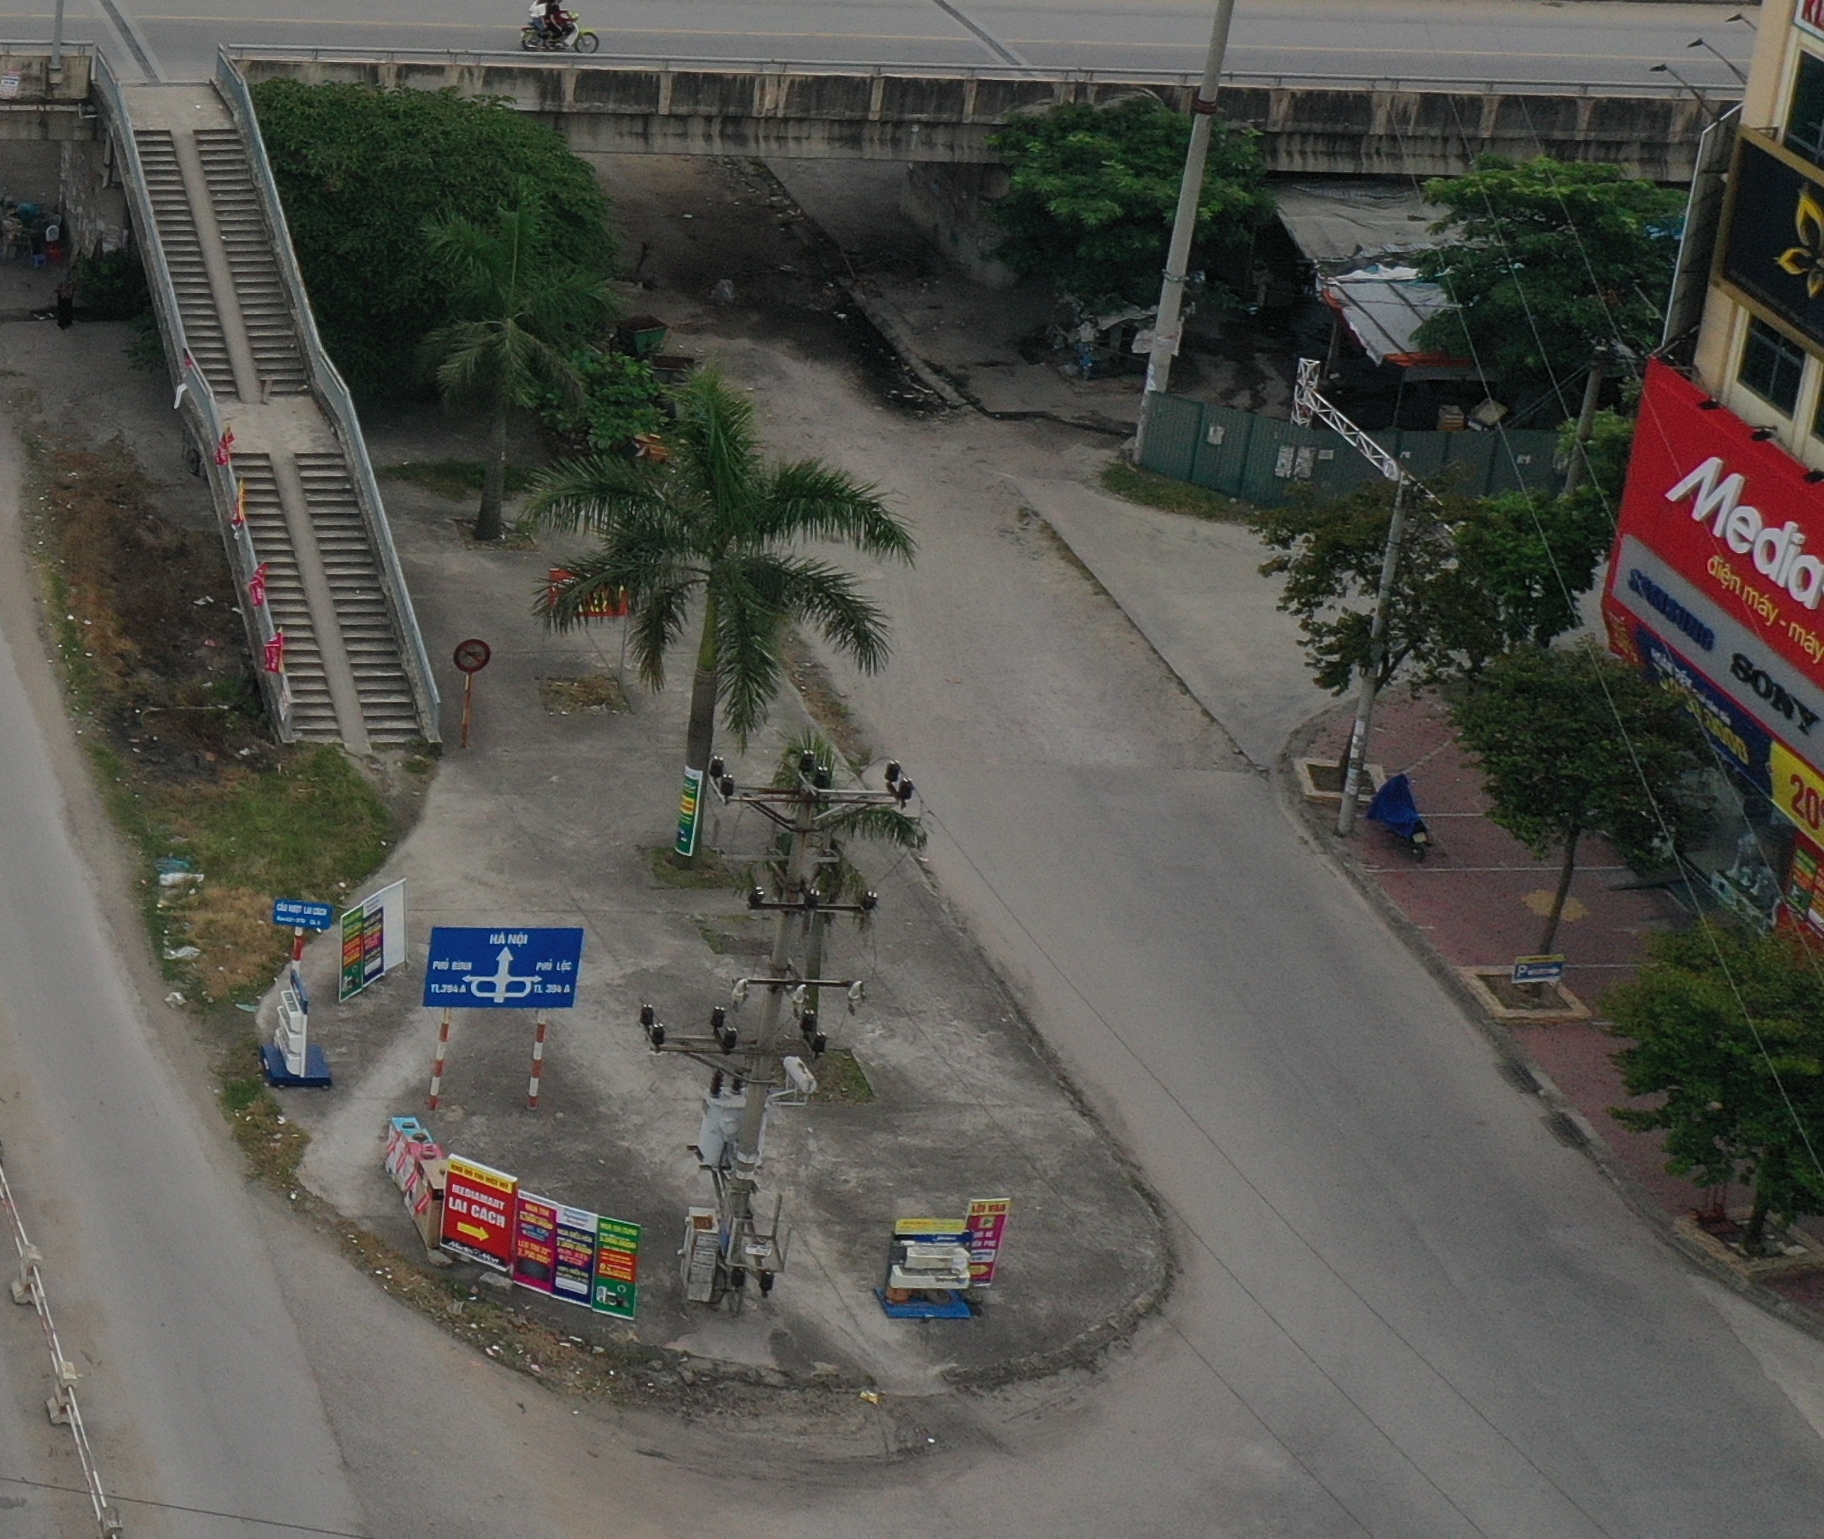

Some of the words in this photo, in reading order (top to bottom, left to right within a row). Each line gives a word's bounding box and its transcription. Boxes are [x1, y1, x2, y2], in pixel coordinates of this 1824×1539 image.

[1664, 457, 1824, 610] Media
[1708, 555, 1740, 597] điện
[1742, 584, 1778, 626] máy
[1729, 652, 1819, 736] SONY
[1790, 774, 1824, 839] 20
[489, 931, 505, 945] HÀ
[507, 931, 528, 947] NỘI
[449, 1197, 467, 1214] LAI
[471, 1204, 505, 1228] CÁCH
